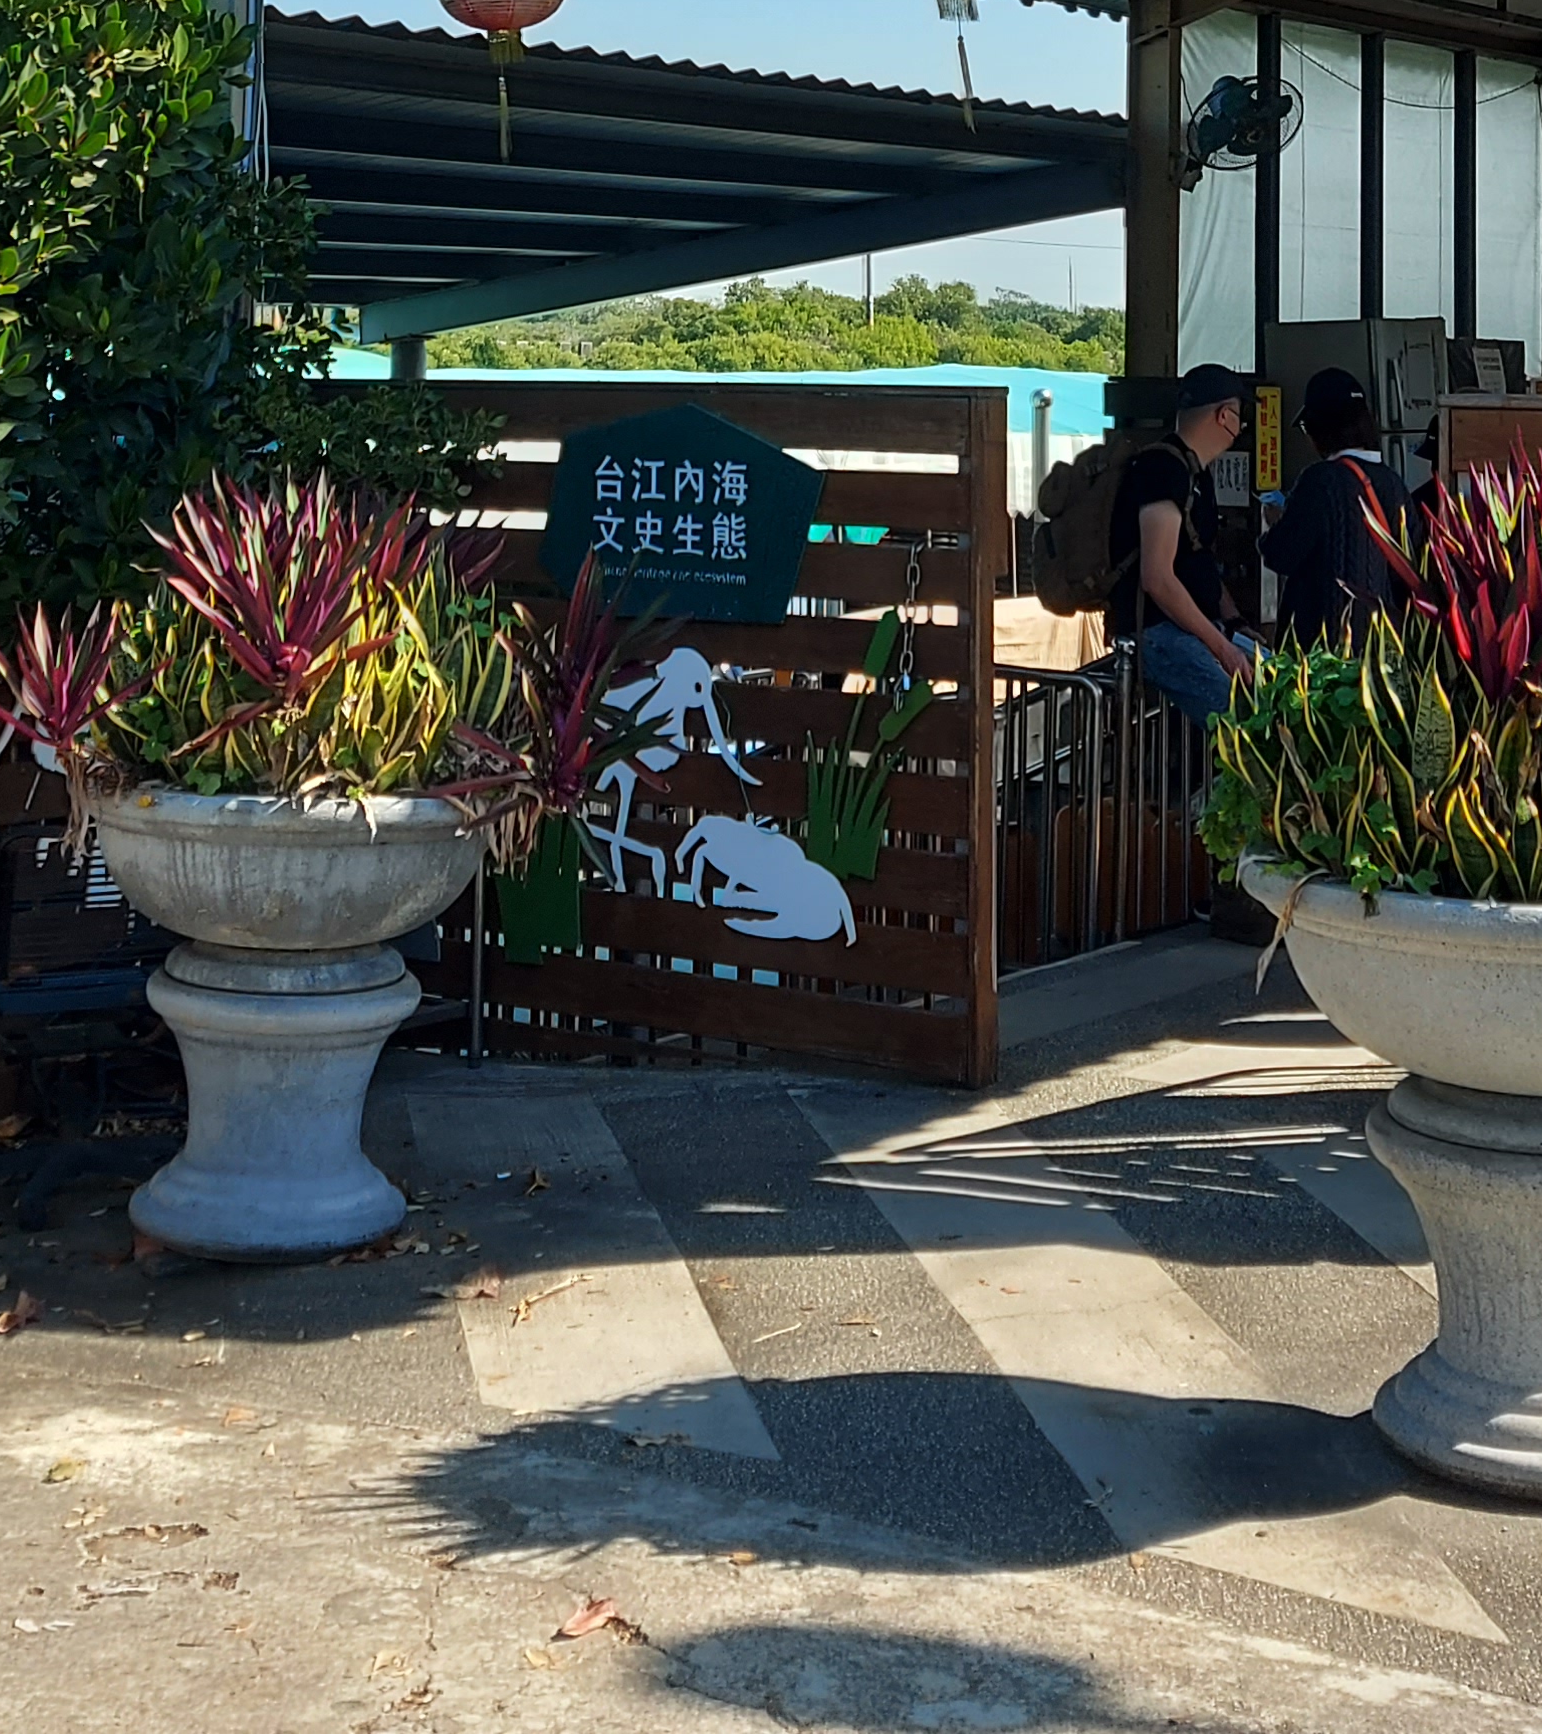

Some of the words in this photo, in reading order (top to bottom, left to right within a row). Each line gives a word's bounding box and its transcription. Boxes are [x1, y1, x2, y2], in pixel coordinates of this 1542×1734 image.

[594, 454, 749, 507] 台江內海
[592, 507, 748, 561] 文史生態
